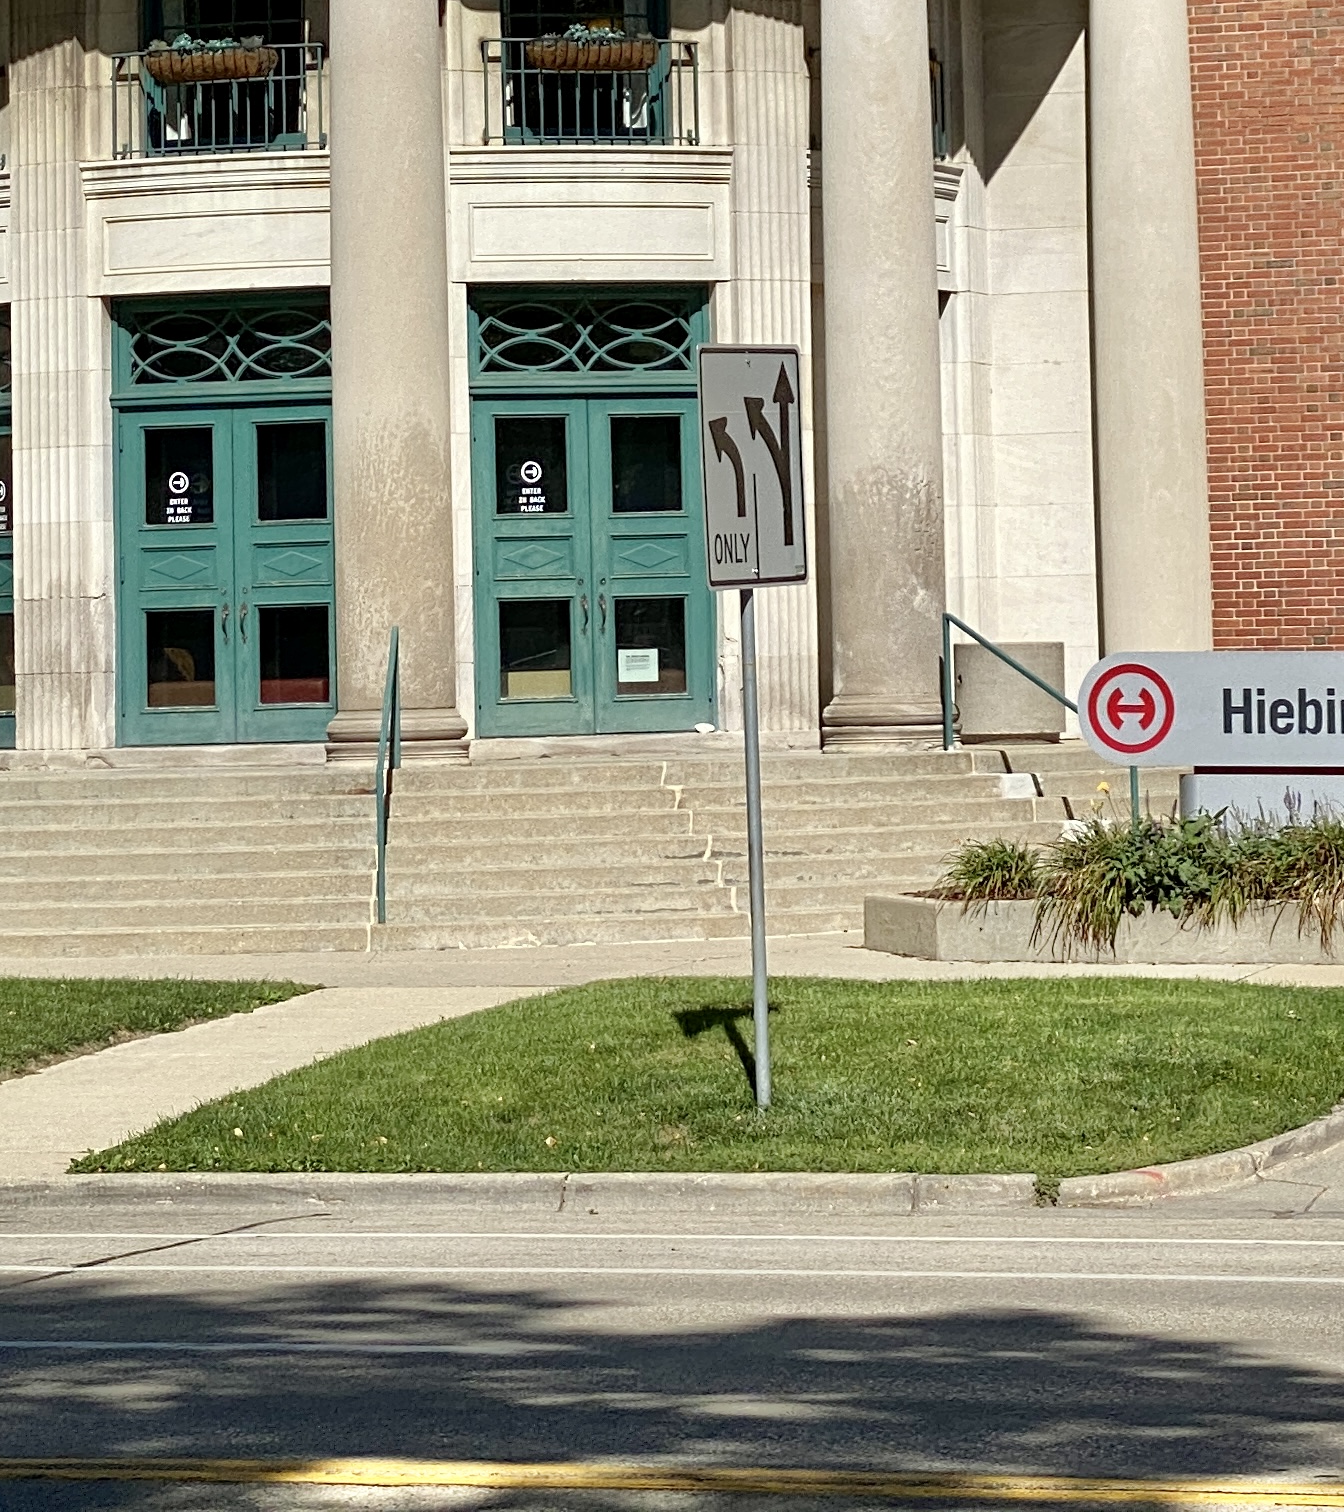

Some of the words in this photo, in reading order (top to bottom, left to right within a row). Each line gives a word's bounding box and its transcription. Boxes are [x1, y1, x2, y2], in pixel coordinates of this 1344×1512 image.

[520, 504, 544, 512] PLEASE
[167, 515, 191, 523] PLEASE
[714, 533, 750, 565] ONLY
